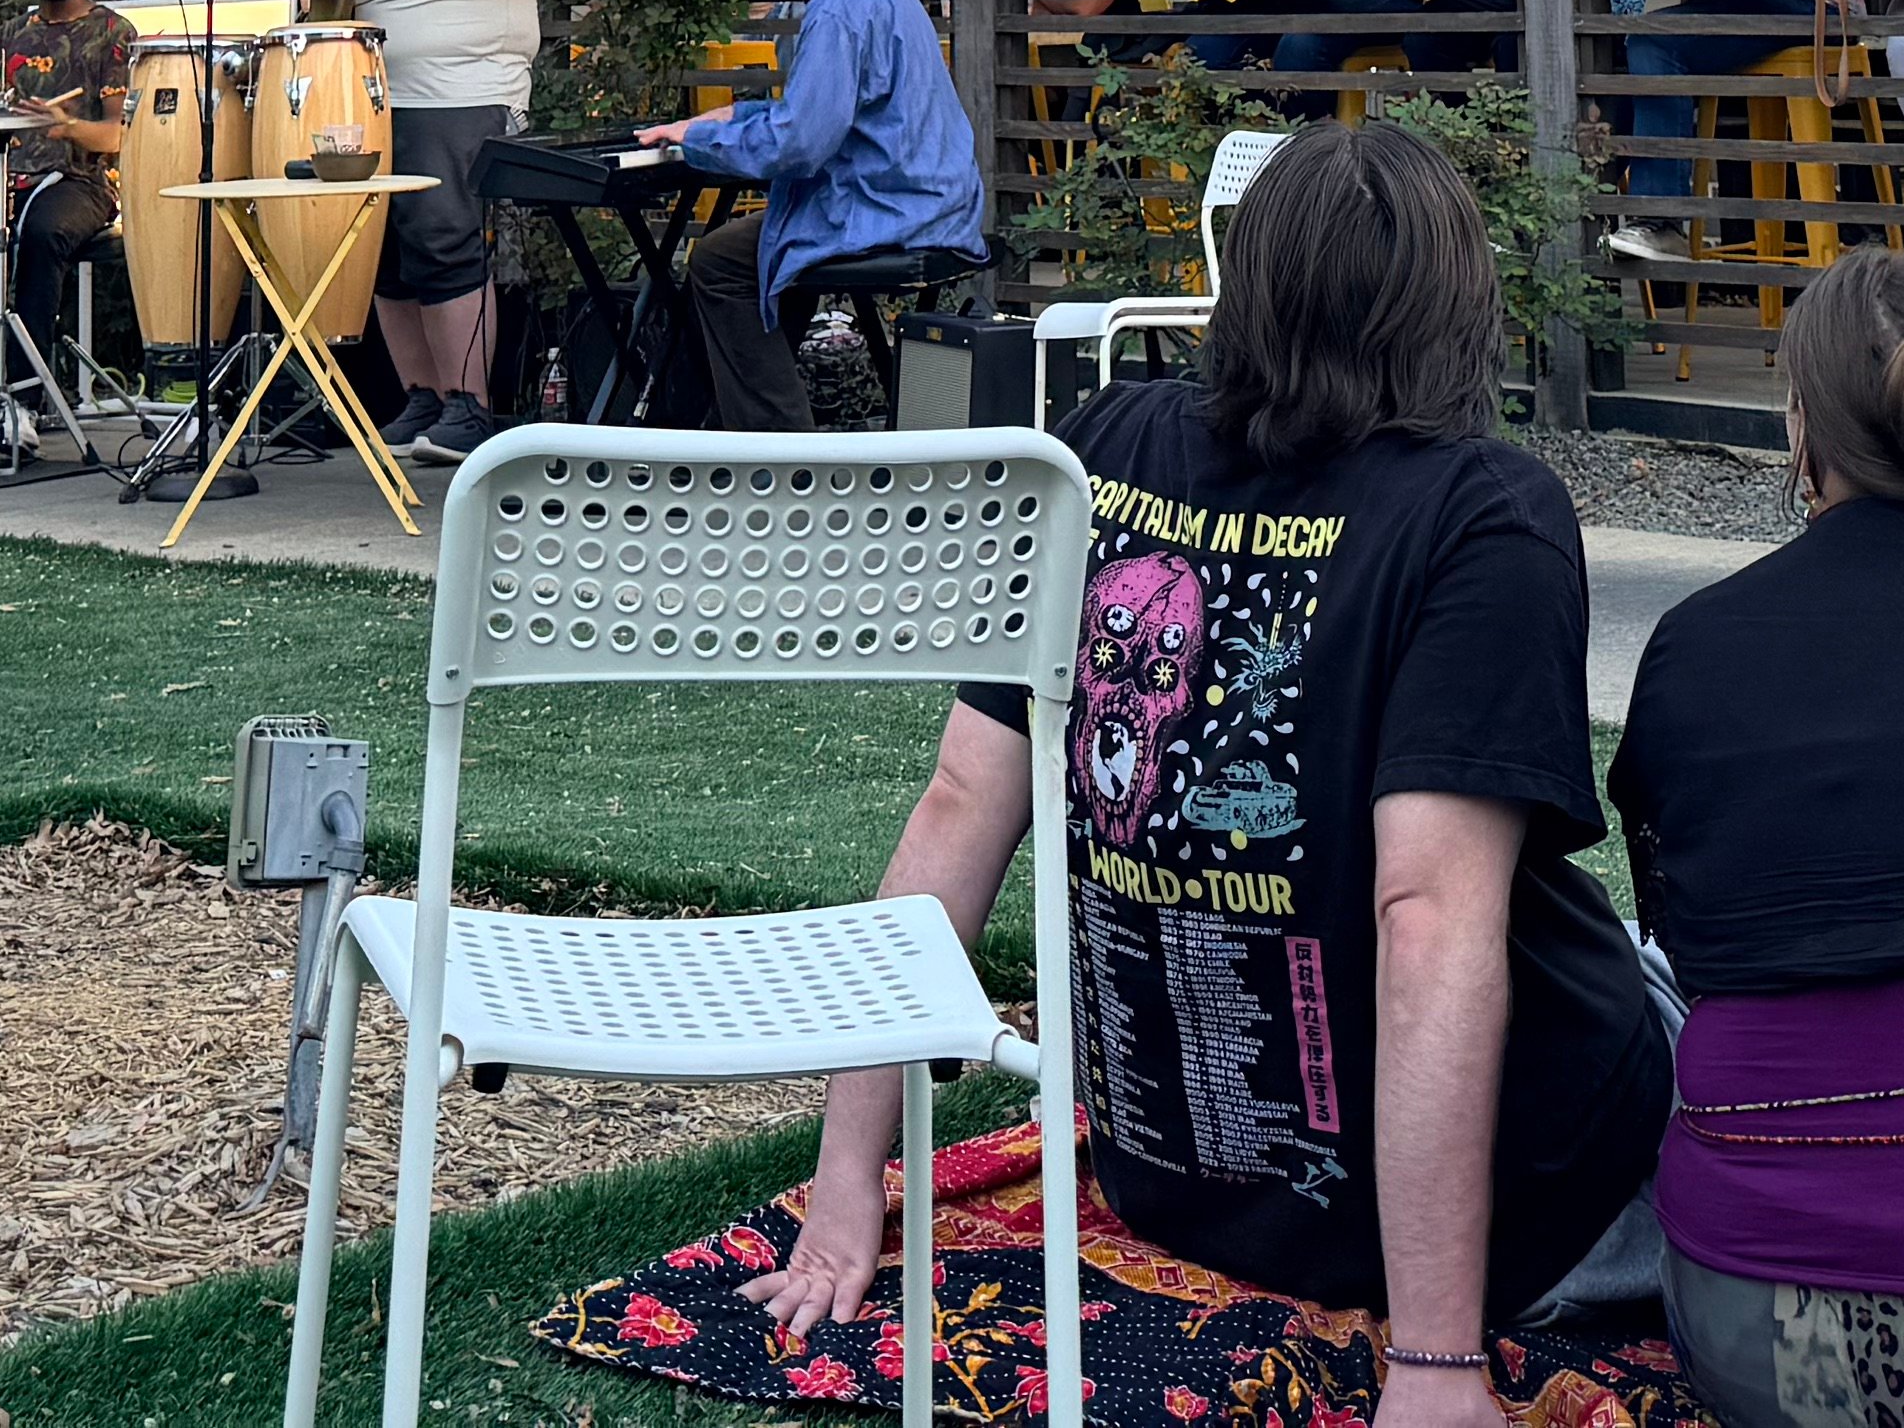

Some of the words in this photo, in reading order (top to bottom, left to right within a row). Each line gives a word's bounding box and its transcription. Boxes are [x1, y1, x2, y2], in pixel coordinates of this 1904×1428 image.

[1210, 513, 1245, 553] IN
[1252, 513, 1345, 558] DECAY
[1088, 839, 1181, 904] WORLD
[1202, 869, 1295, 915] TOUR
